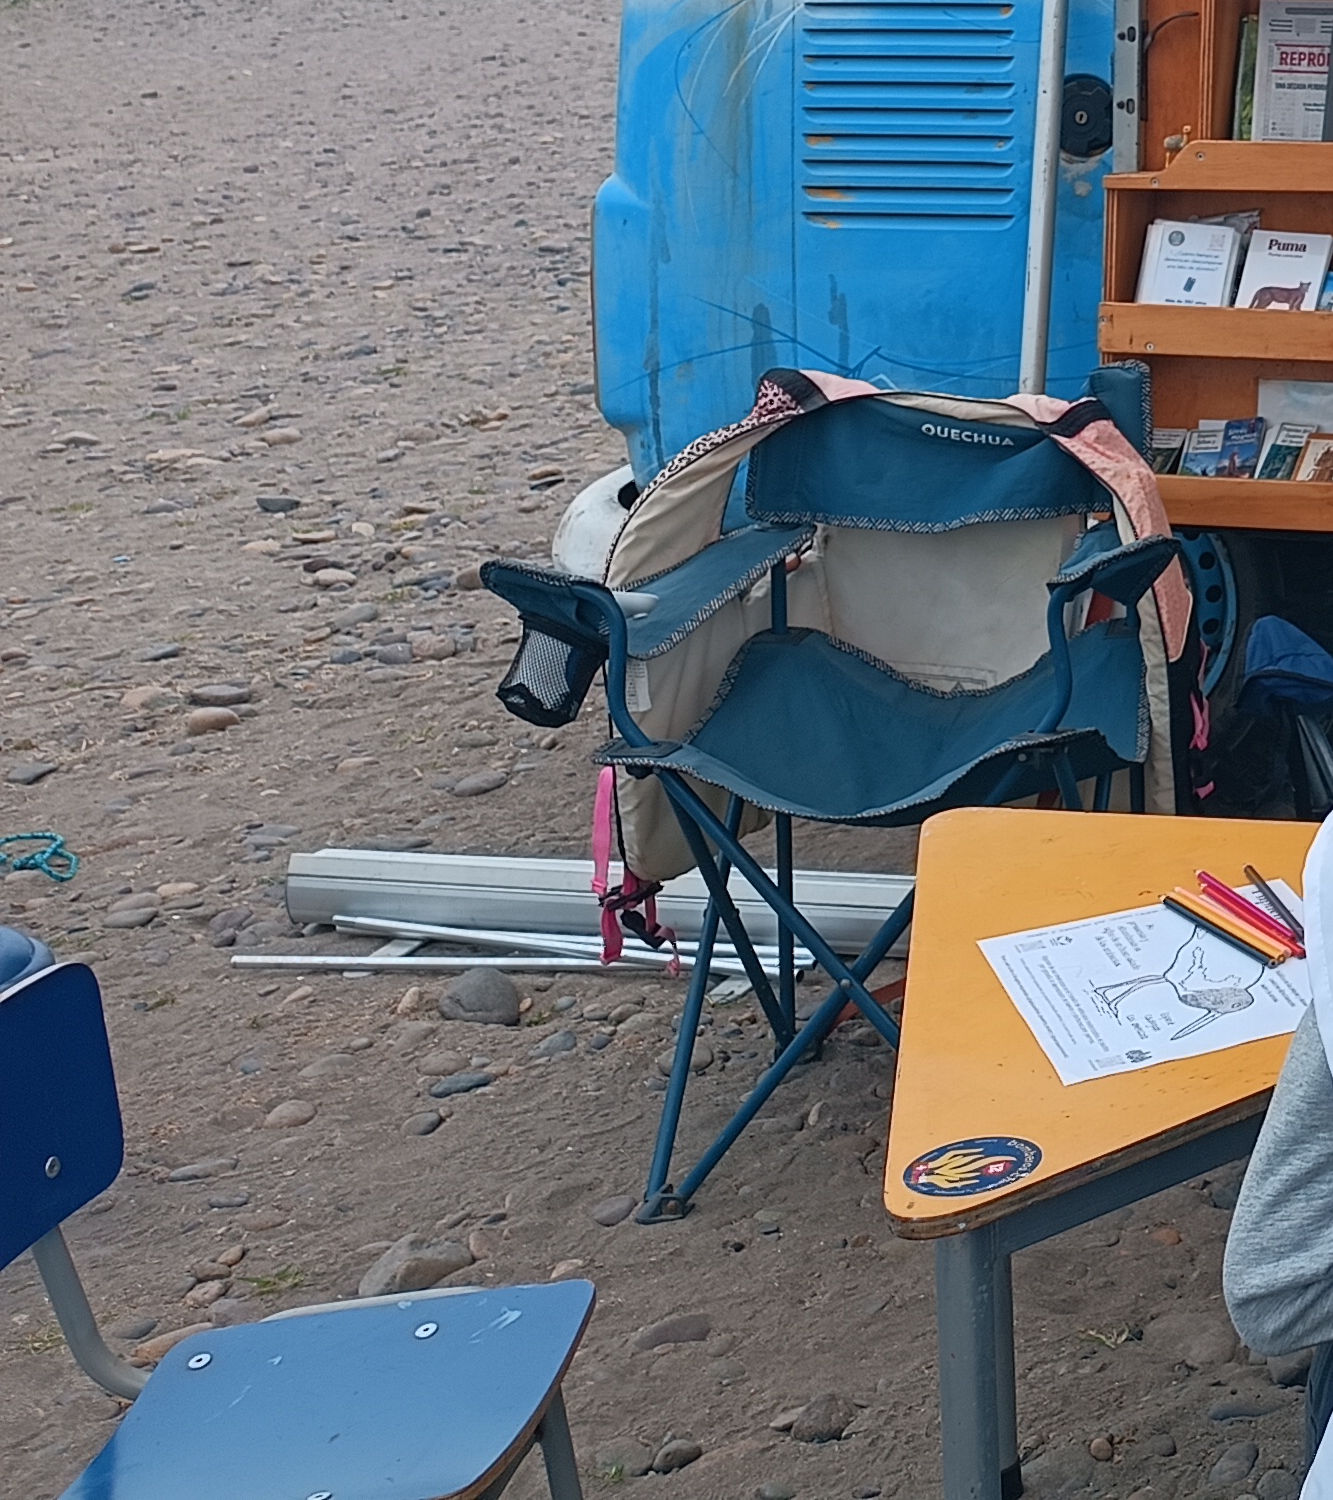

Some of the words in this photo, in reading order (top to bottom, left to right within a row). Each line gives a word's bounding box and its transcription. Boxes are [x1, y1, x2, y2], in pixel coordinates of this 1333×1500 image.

[1279, 51, 1330, 67] REPRO
[1267, 238, 1307, 253] Puma
[921, 423, 1015, 447] QUECHUA
